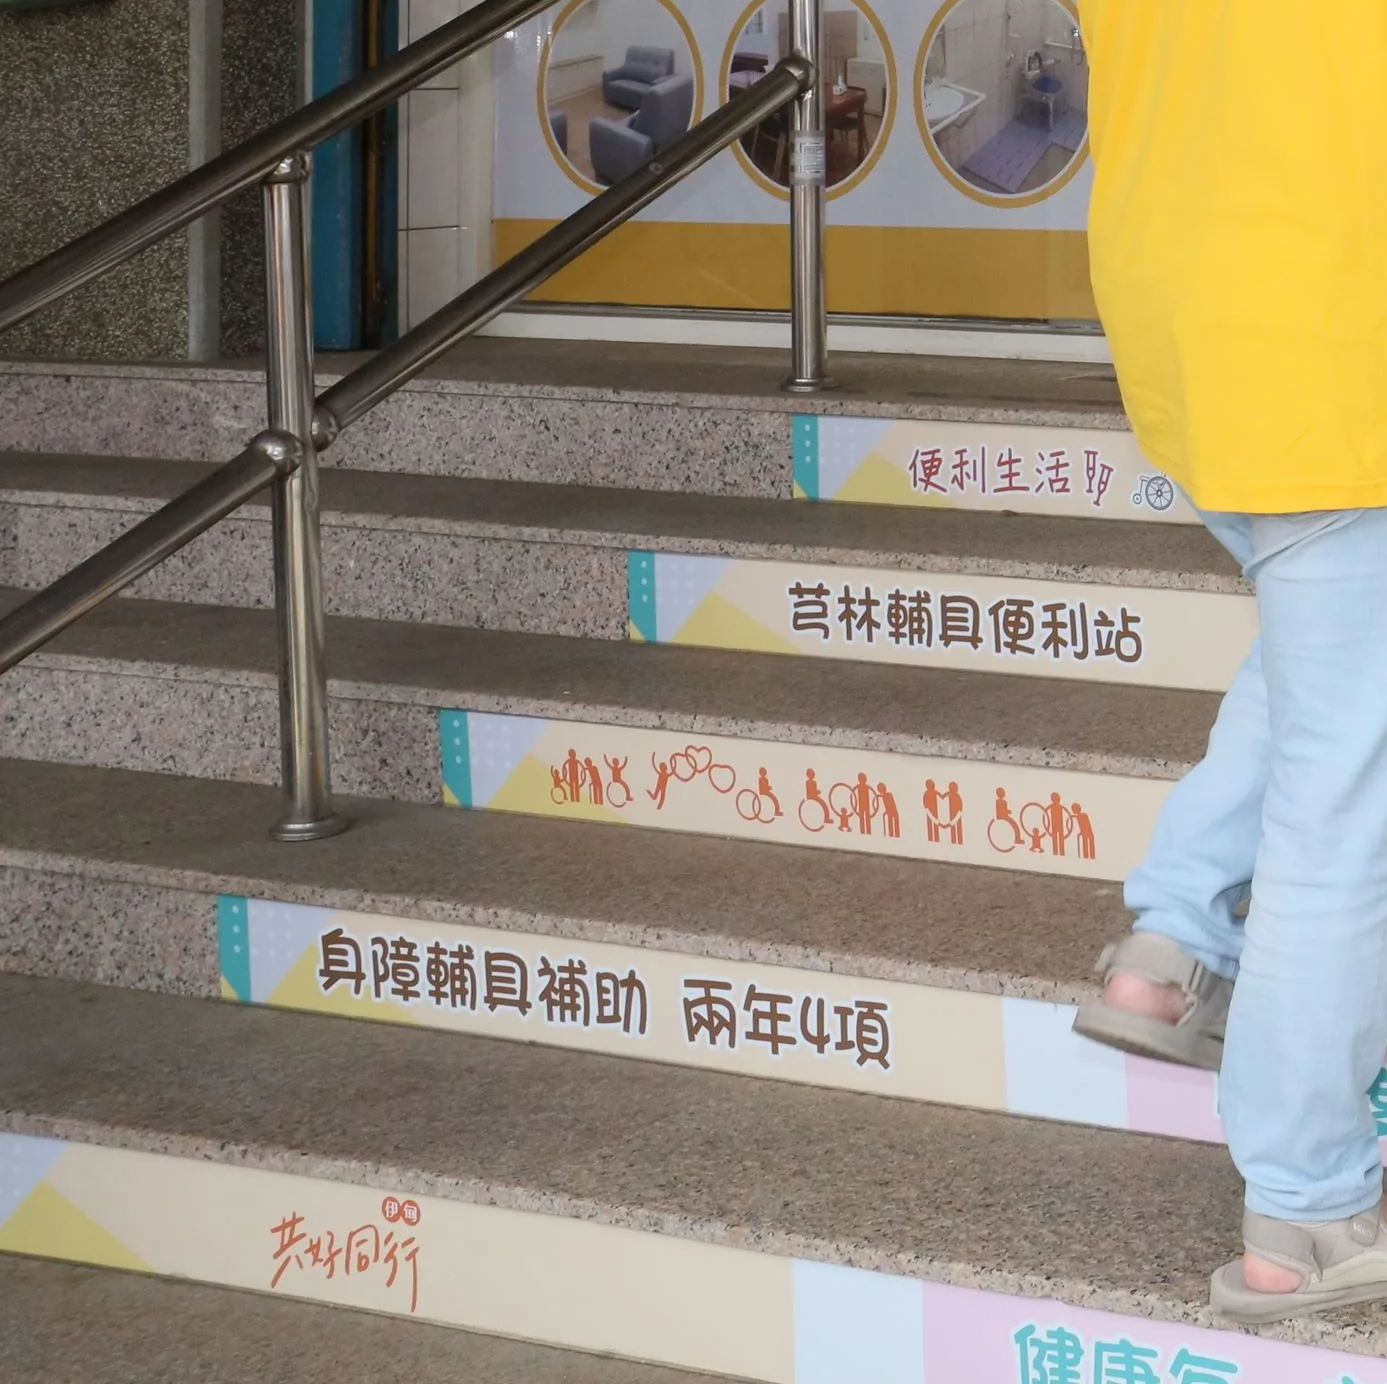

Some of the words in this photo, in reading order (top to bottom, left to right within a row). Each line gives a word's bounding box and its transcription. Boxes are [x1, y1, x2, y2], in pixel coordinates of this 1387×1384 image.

[788, 581, 1142, 663] 芎林輔具便利站
[318, 929, 649, 1035] 身障輔具補助
[683, 976, 893, 1073] 兩年4項
[384, 1200, 418, 1222] 伊甸
[270, 1211, 419, 1312] 共好同行
